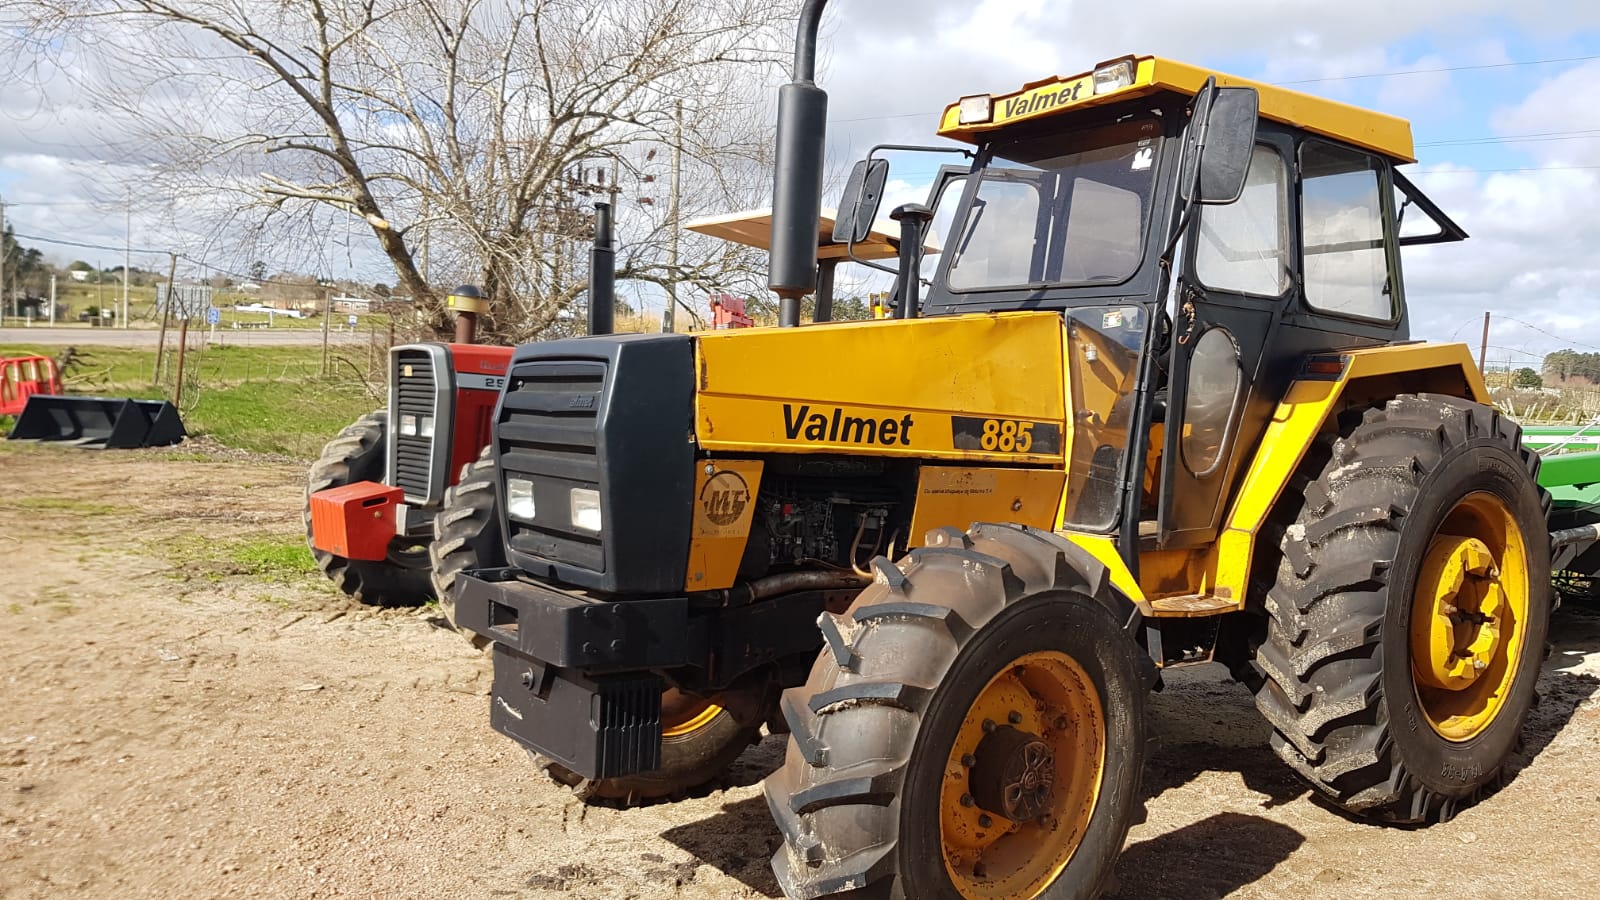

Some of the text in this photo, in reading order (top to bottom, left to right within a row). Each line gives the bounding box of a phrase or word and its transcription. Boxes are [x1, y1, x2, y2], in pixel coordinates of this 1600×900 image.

[1006, 81, 1083, 118] Valmet
[783, 404, 914, 446] Valmet
[981, 419, 1034, 452] 885
